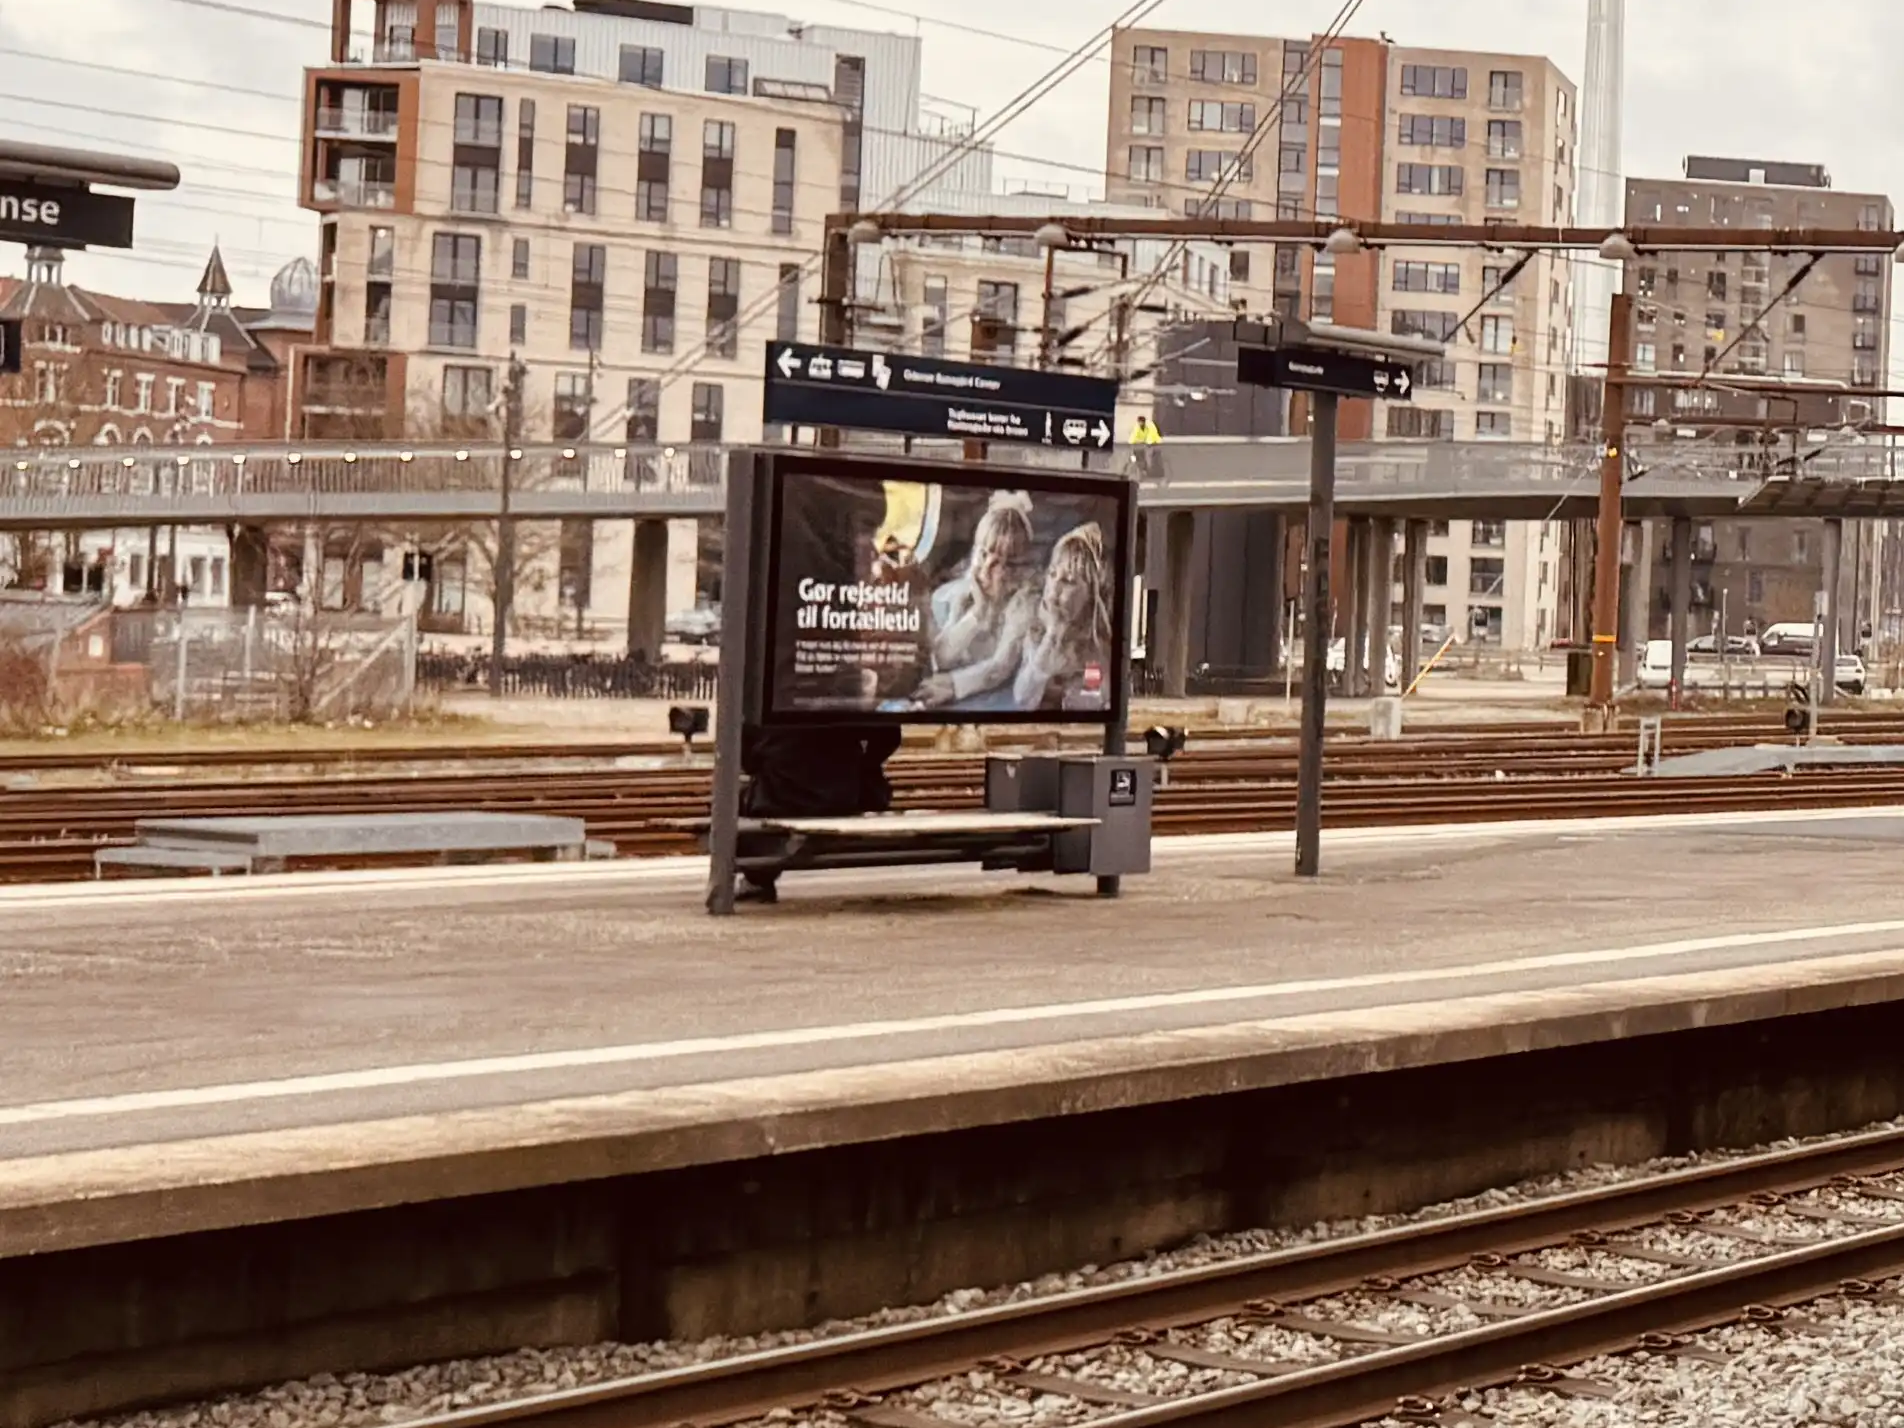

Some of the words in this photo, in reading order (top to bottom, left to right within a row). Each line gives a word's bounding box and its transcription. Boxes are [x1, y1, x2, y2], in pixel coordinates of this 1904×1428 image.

[0, 194, 60, 225] nse
[839, 580, 909, 608] rejsetid
[797, 604, 818, 629] til
[822, 604, 920, 632] fortælletid
